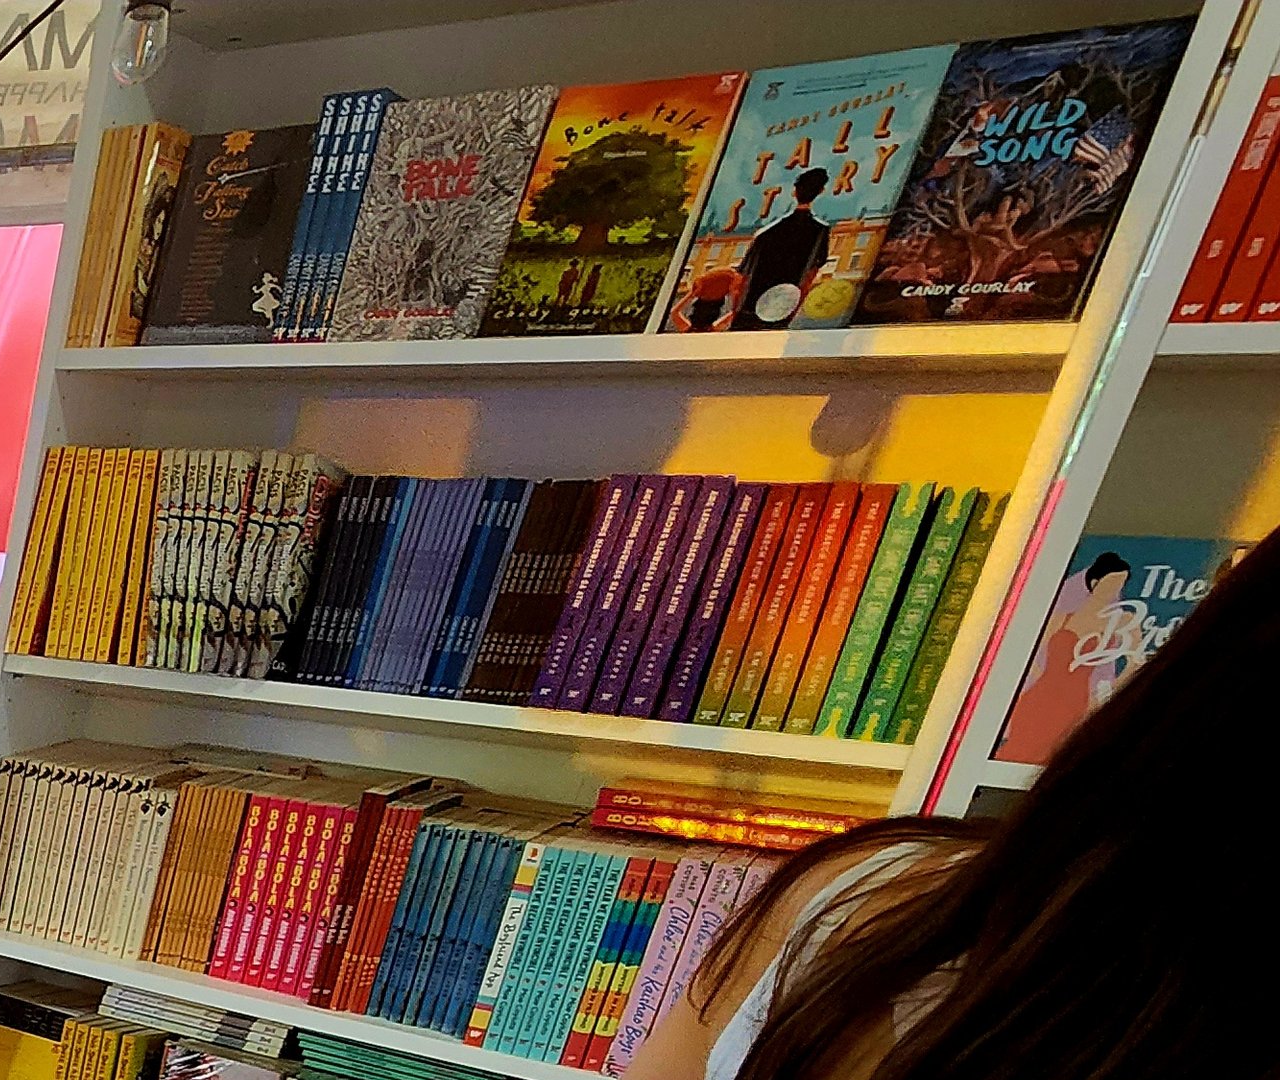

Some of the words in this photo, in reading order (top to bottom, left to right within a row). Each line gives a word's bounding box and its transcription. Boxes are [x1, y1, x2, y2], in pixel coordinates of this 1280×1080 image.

[983, 98, 1087, 139] WILD
[752, 105, 896, 185] TALL
[974, 127, 1081, 167] SONG
[406, 153, 481, 182] BONE
[402, 174, 476, 200] TALK
[901, 284, 956, 298] CANDY
[957, 280, 1036, 295] GOURLAY
[1140, 564, 1213, 600] The
